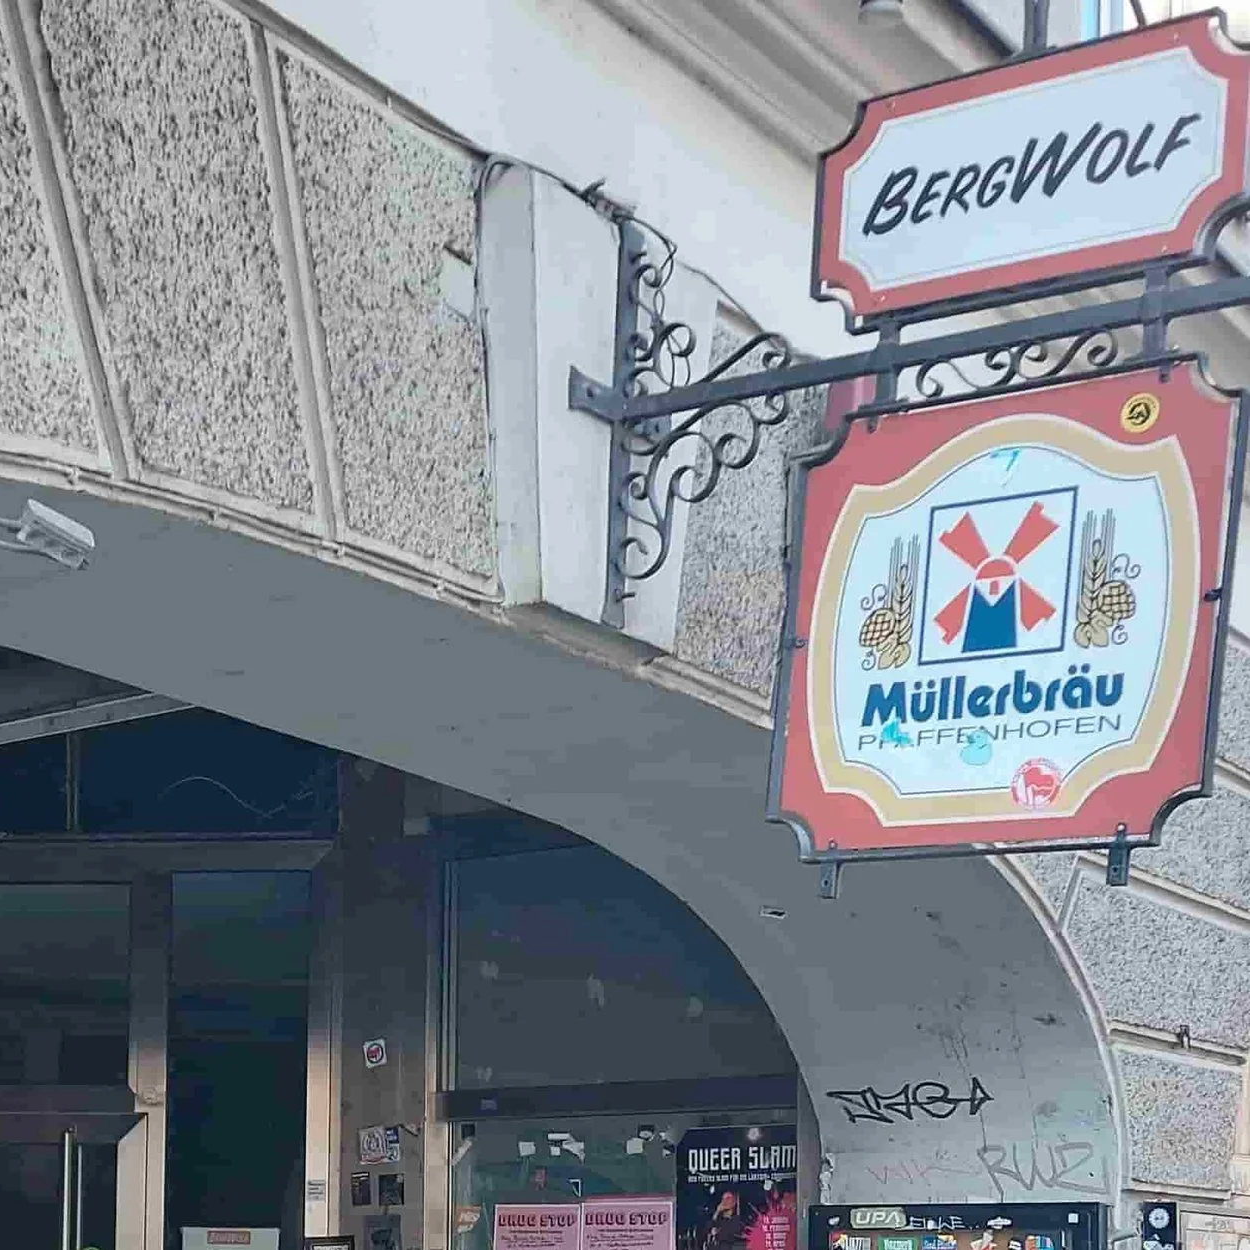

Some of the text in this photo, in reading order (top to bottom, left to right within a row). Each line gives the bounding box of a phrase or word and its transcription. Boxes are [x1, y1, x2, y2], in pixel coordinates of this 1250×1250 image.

[862, 112, 1202, 237] BERGWOLF
[861, 663, 1125, 727] Müllerbräu
[688, 1145, 797, 1174] QUEER SLAM
